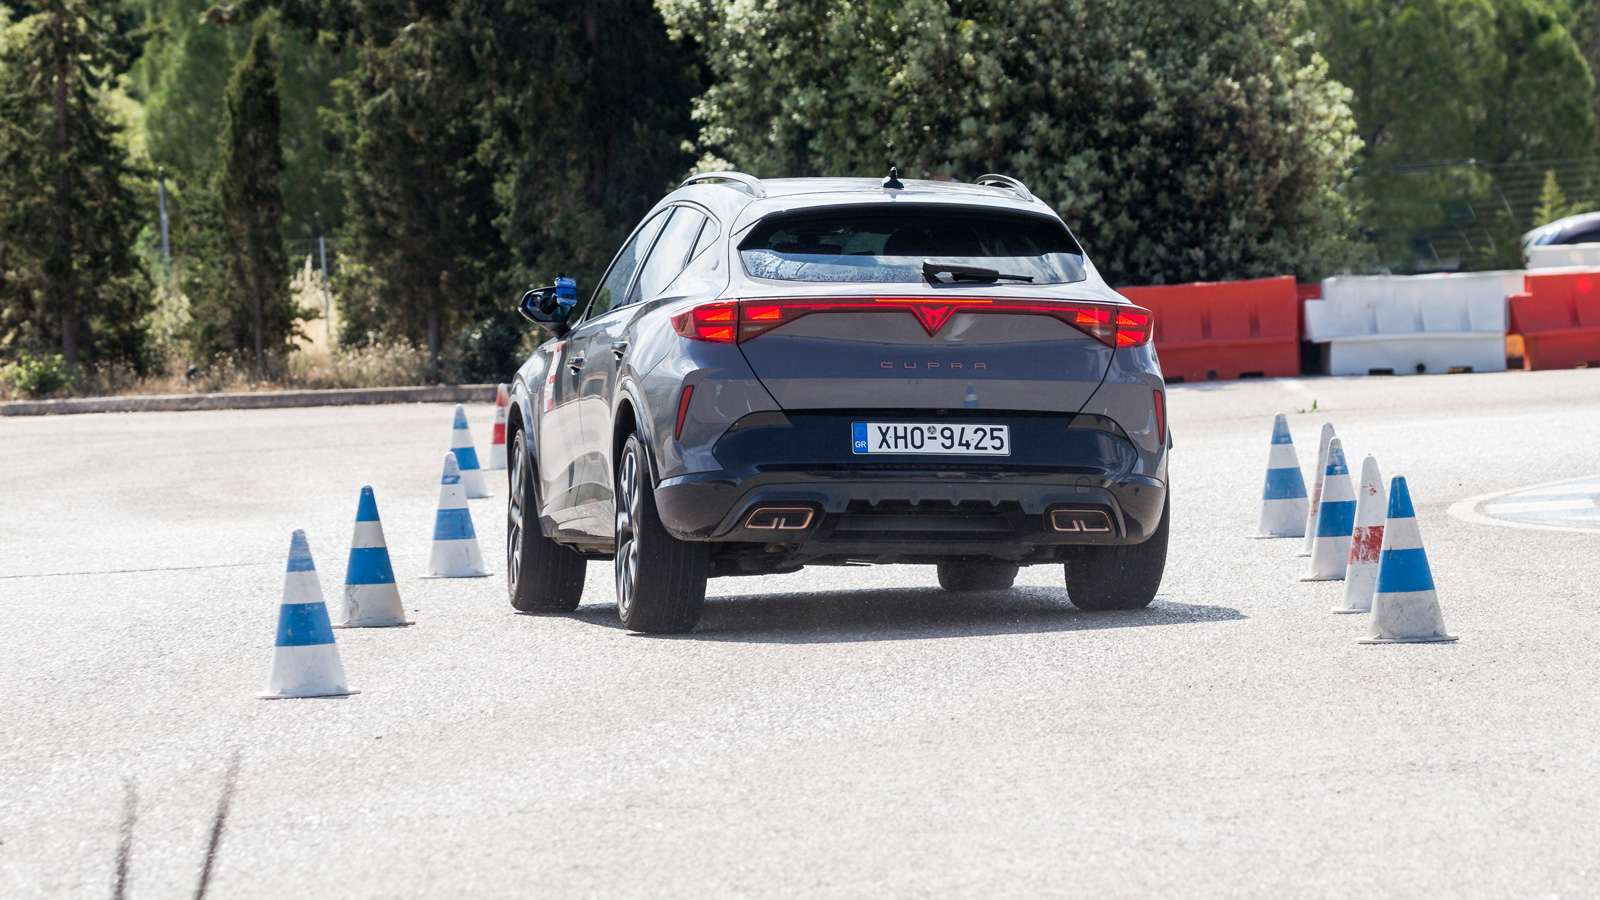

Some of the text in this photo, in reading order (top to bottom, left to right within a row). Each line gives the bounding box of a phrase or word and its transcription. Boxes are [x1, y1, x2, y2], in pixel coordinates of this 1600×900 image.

[880, 361, 987, 370] CUPRA
[877, 426, 1005, 451] XHO-9425
[855, 440, 867, 448] GR
